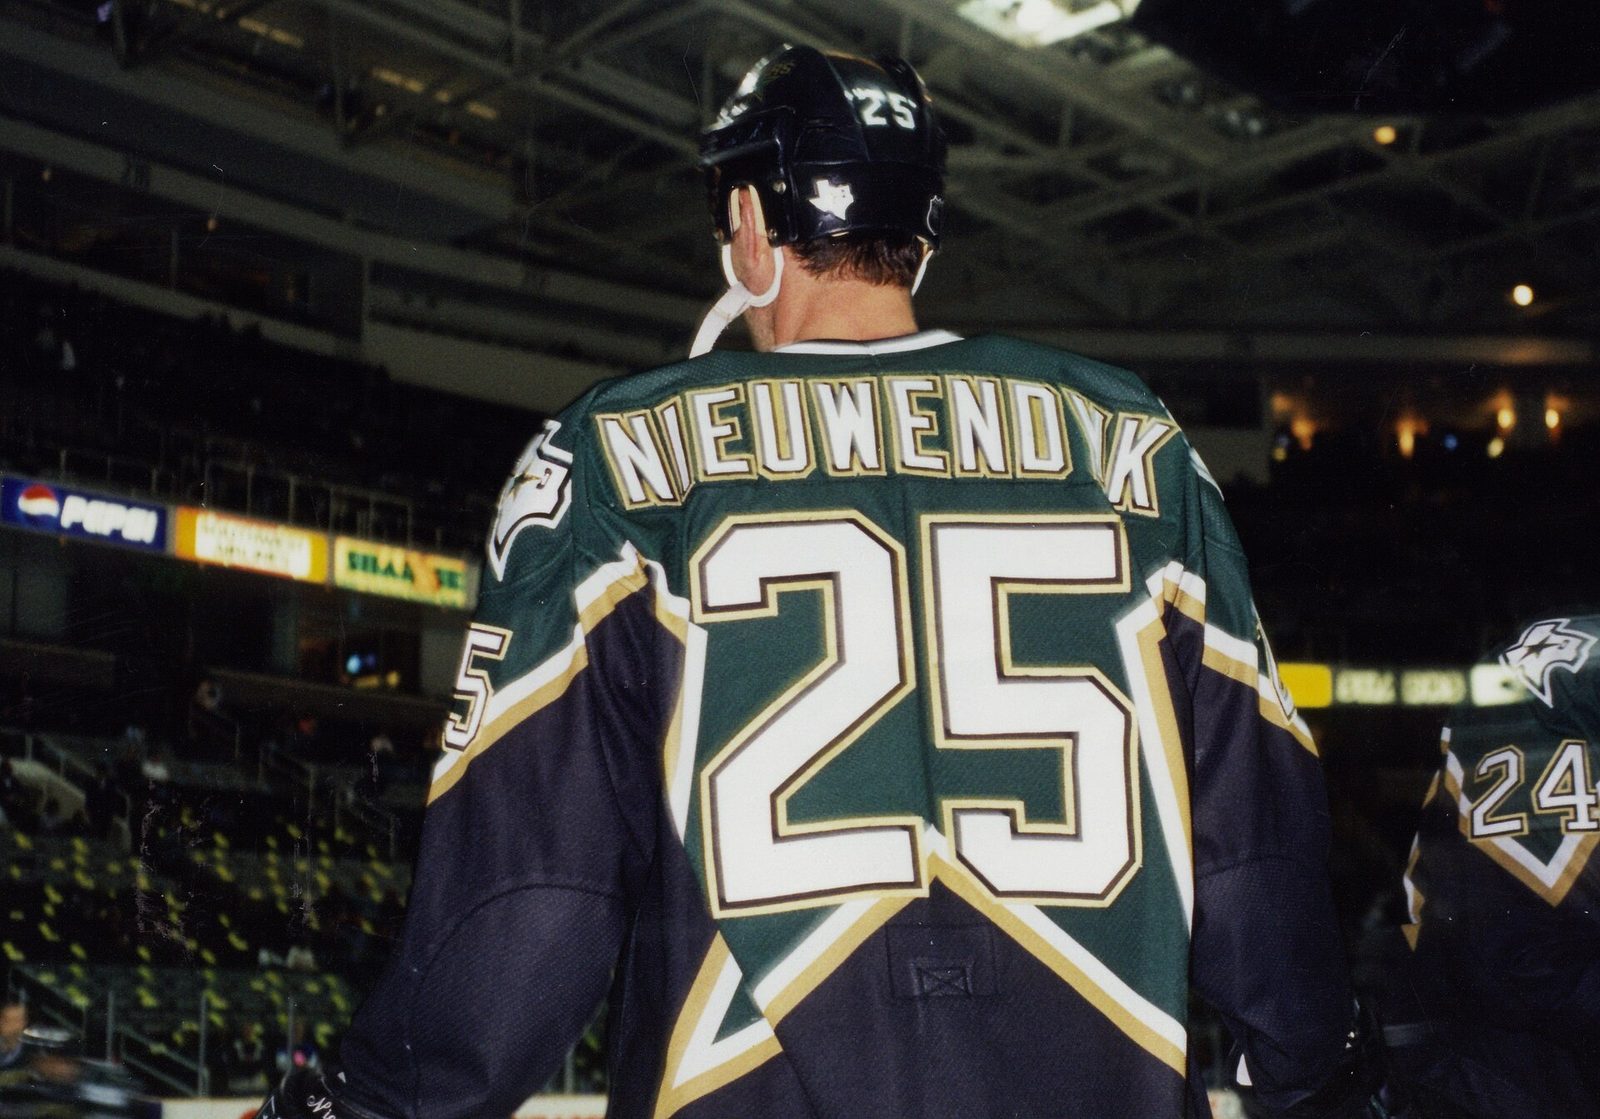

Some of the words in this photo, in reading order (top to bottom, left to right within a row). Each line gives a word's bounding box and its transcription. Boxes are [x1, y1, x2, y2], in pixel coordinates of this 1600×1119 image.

[851, 87, 917, 130] 25
[595, 373, 1178, 518] NIEUWENDYK
[689, 508, 1143, 919] 25
[1467, 739, 1600, 842] 24
